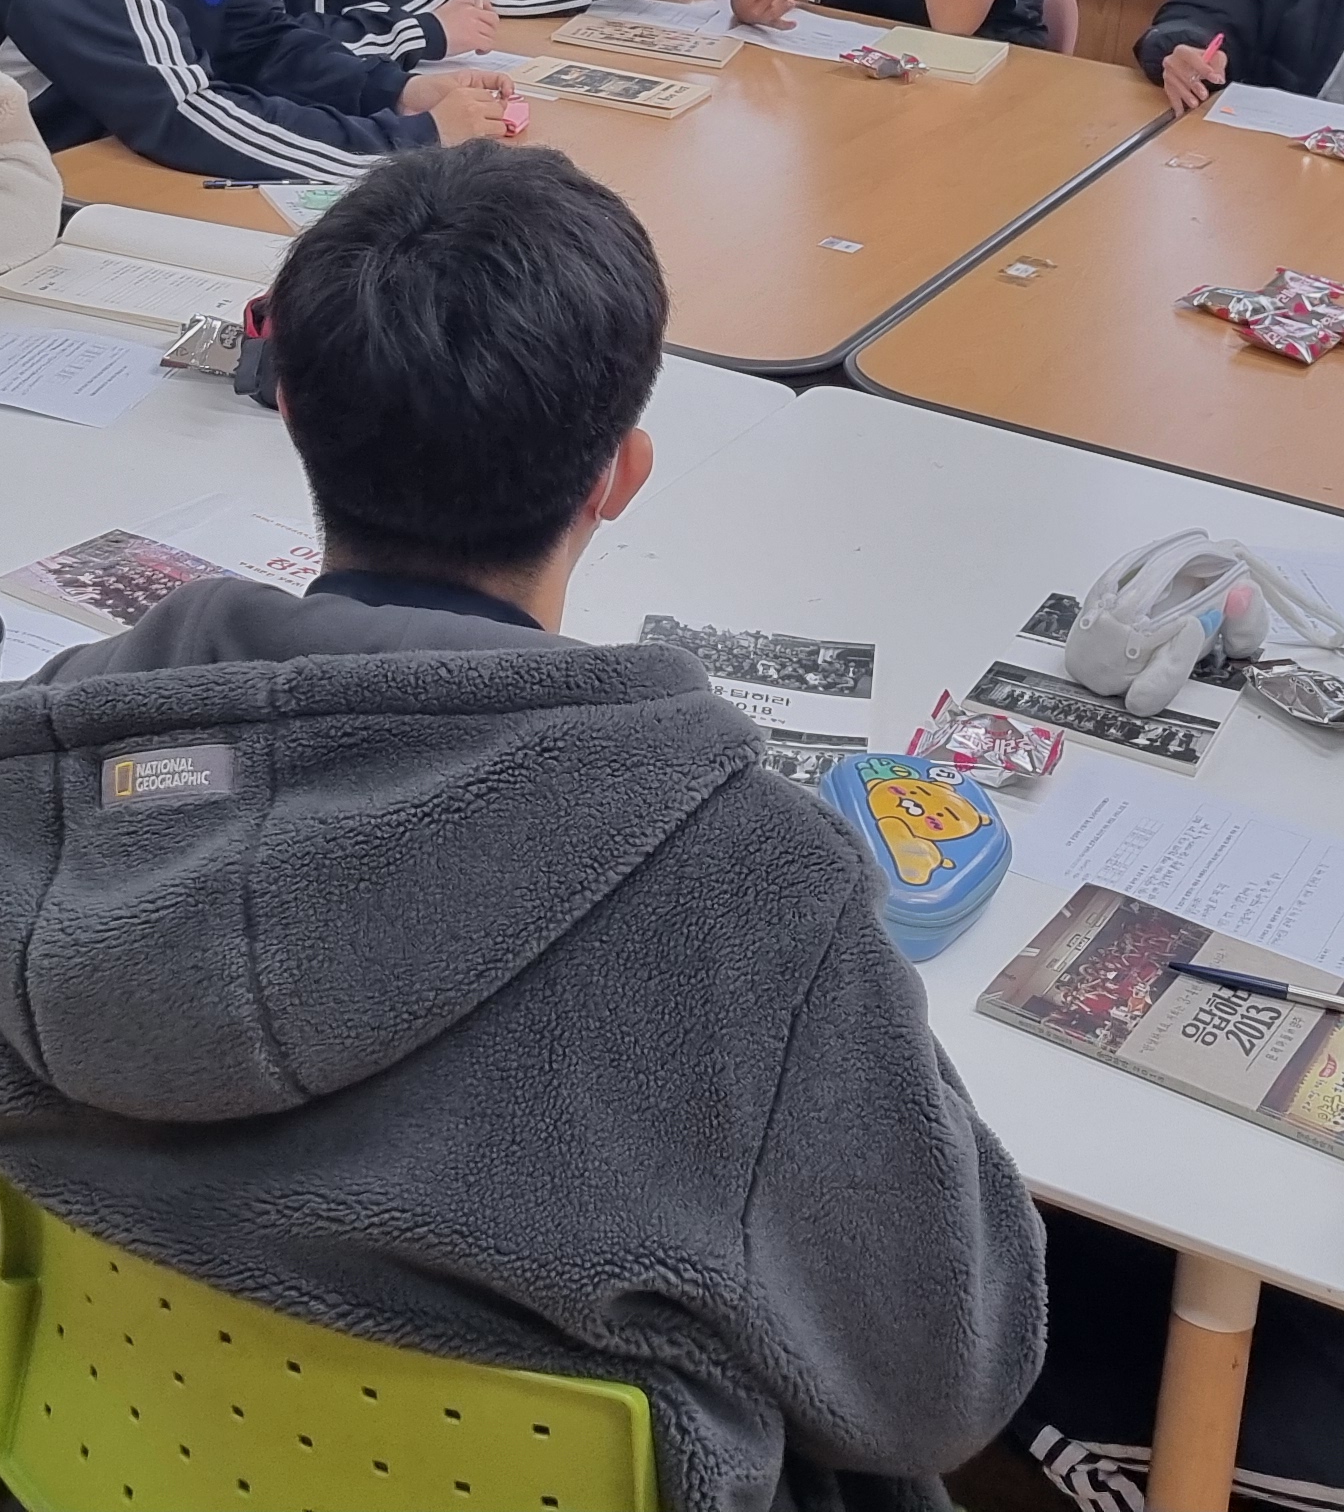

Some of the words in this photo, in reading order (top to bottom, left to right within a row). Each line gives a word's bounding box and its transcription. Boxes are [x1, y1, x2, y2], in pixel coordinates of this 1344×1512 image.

[735, 702, 773, 716] 018
[136, 757, 194, 779] NATIONAL
[136, 770, 211, 792] GEOGRAPHIC
[1225, 1004, 1283, 1057] 2013
